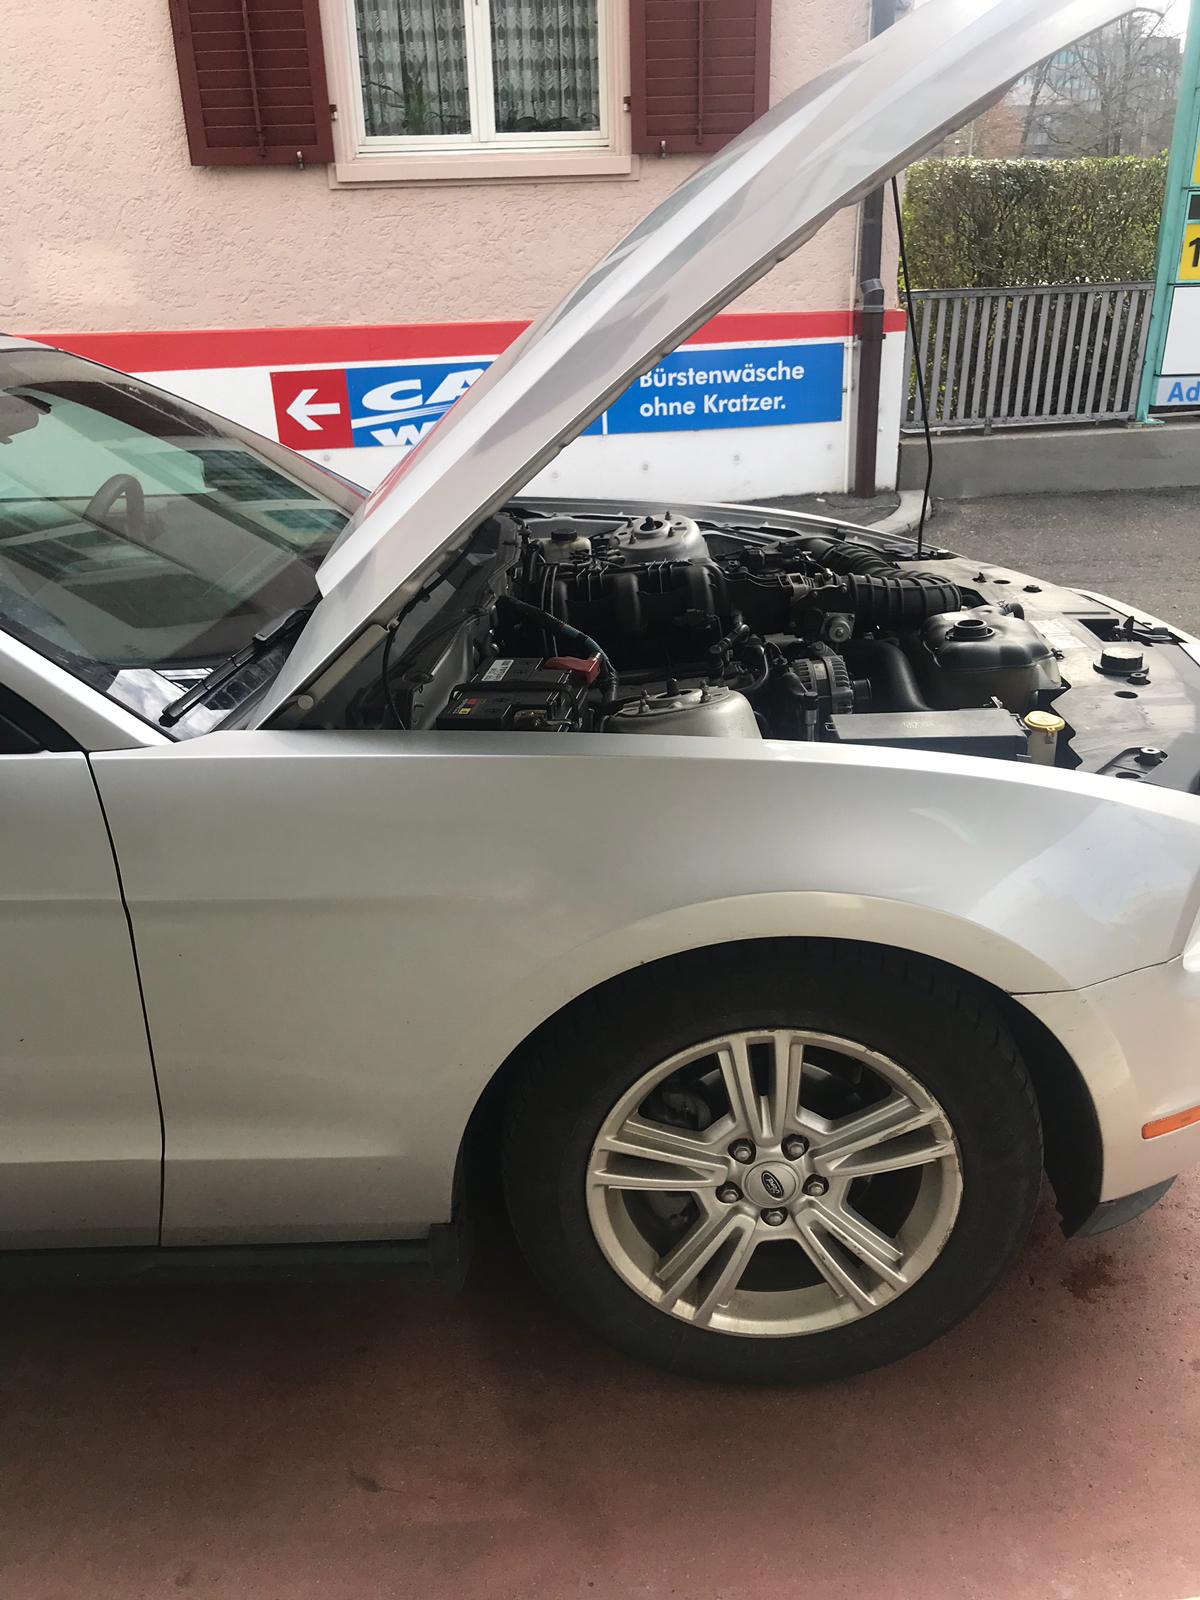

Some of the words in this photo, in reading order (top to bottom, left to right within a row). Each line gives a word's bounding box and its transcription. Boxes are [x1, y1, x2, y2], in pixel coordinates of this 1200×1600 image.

[639, 360, 805, 388] Bürstenwäsche
[639, 396, 696, 417] ohne
[703, 394, 787, 414] Kratzer.
